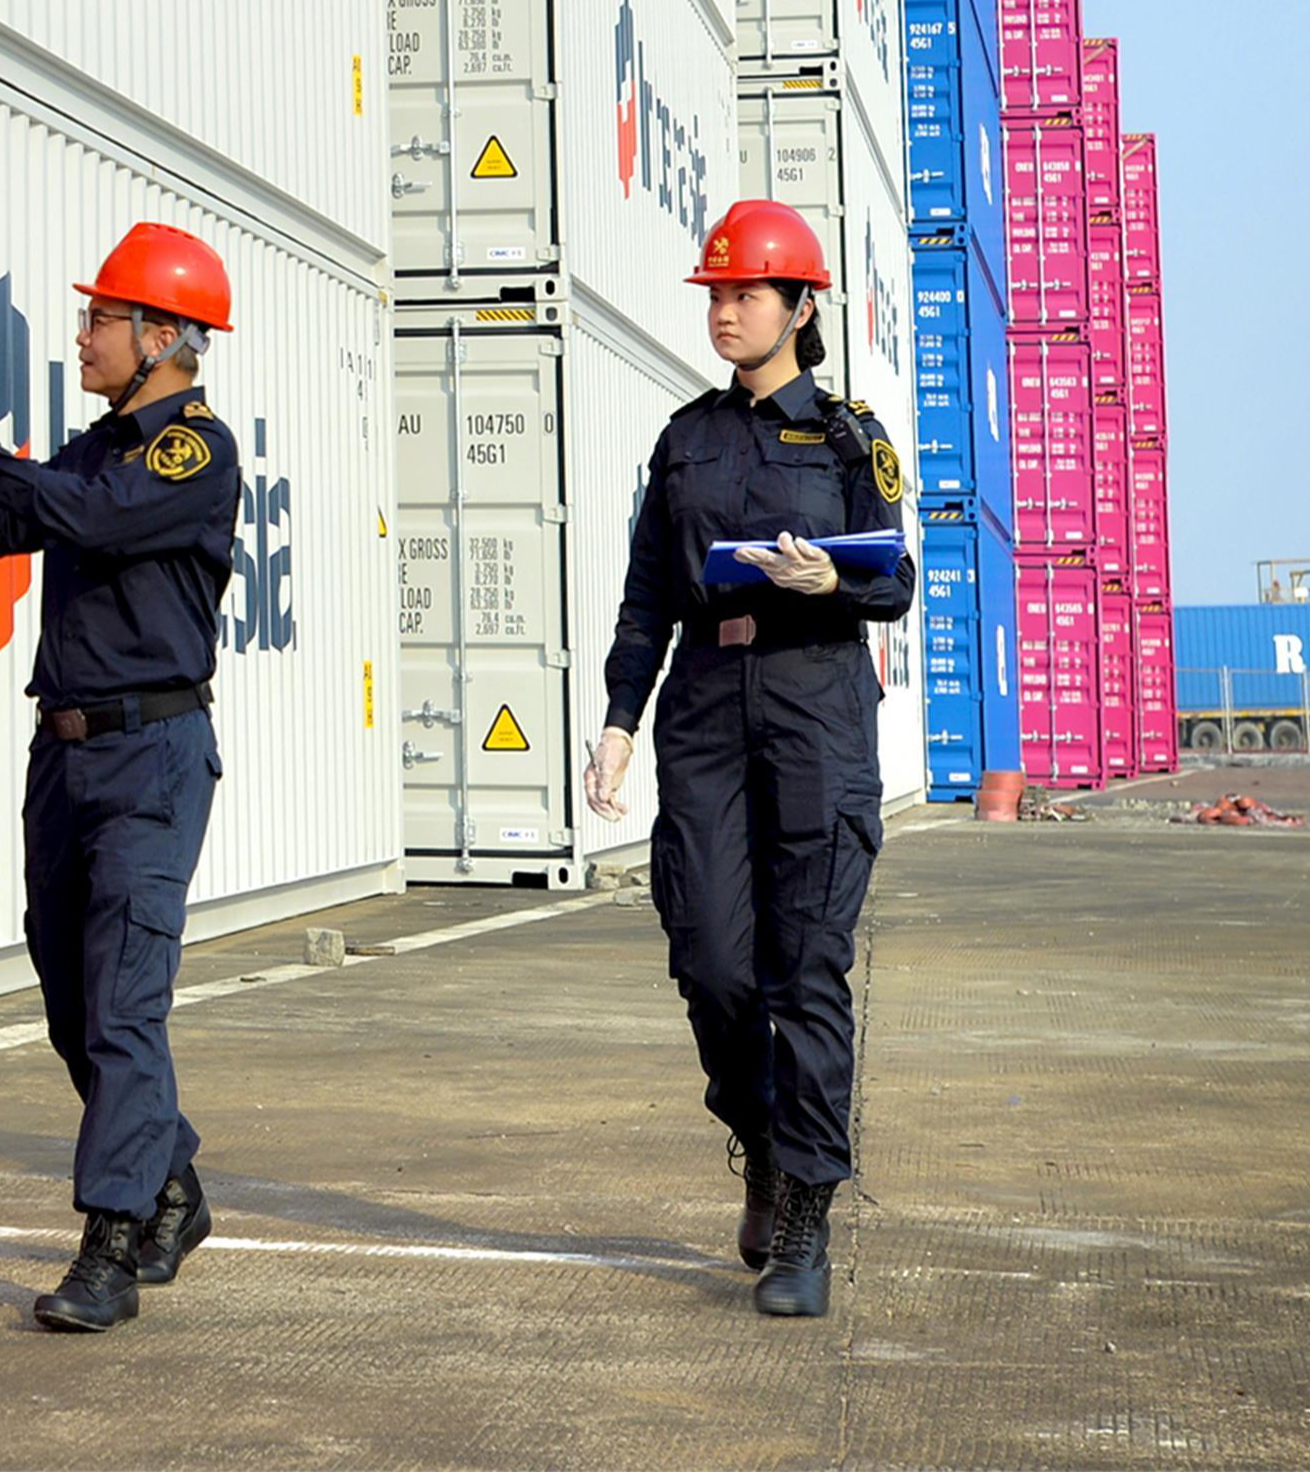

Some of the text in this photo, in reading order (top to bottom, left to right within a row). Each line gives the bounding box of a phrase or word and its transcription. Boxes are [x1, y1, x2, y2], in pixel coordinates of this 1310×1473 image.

[388, 32, 420, 53] LOAD
[777, 168, 803, 181] 45G1
[467, 414, 525, 435] 104750
[544, 412, 554, 433] 0
[467, 444, 506, 464] 45G1
[409, 538, 448, 560] GROSS
[1273, 635, 1305, 673] R
